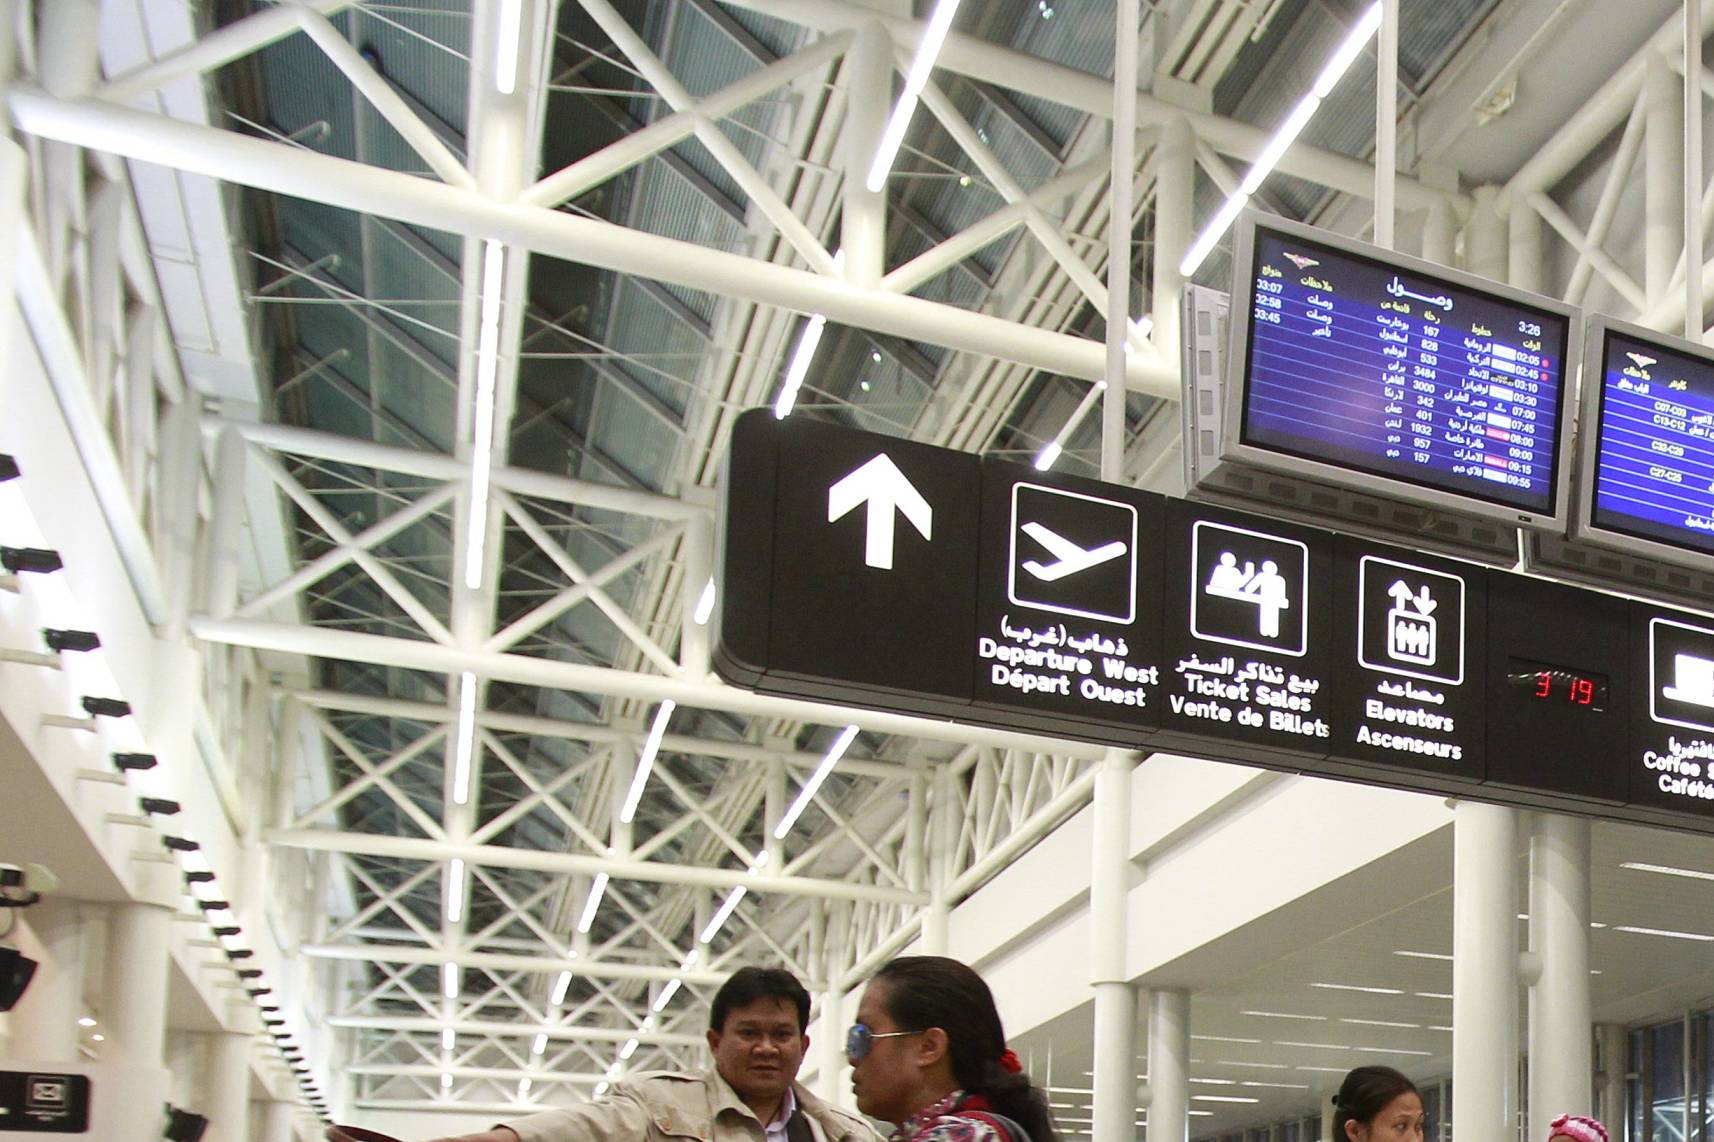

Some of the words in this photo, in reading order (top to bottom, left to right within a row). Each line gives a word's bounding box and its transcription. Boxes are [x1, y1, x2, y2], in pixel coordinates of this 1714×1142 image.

[1423, 325, 1440, 338] 167
[1518, 321, 1541, 336] 3:26
[1069, 635, 1129, 657] ذهاب
[979, 637, 1092, 676] Departure
[1103, 657, 1158, 685] West
[1176, 654, 1235, 677] السفر
[1235, 659, 1285, 689] تذاكر
[992, 664, 1071, 697] Départ
[1081, 682, 1146, 708] Ouest
[1184, 672, 1250, 703] Ticket
[1255, 686, 1312, 713] Sales
[1288, 671, 1320, 695] بيع
[1377, 679, 1445, 706] مصاعد
[1170, 695, 1232, 725] Vente
[1237, 704, 1264, 728] de
[1270, 711, 1330, 738] Billets
[1366, 698, 1455, 733] Elevators
[1356, 725, 1463, 761] Ascenseurs
[1643, 750, 1700, 779] Coffee
